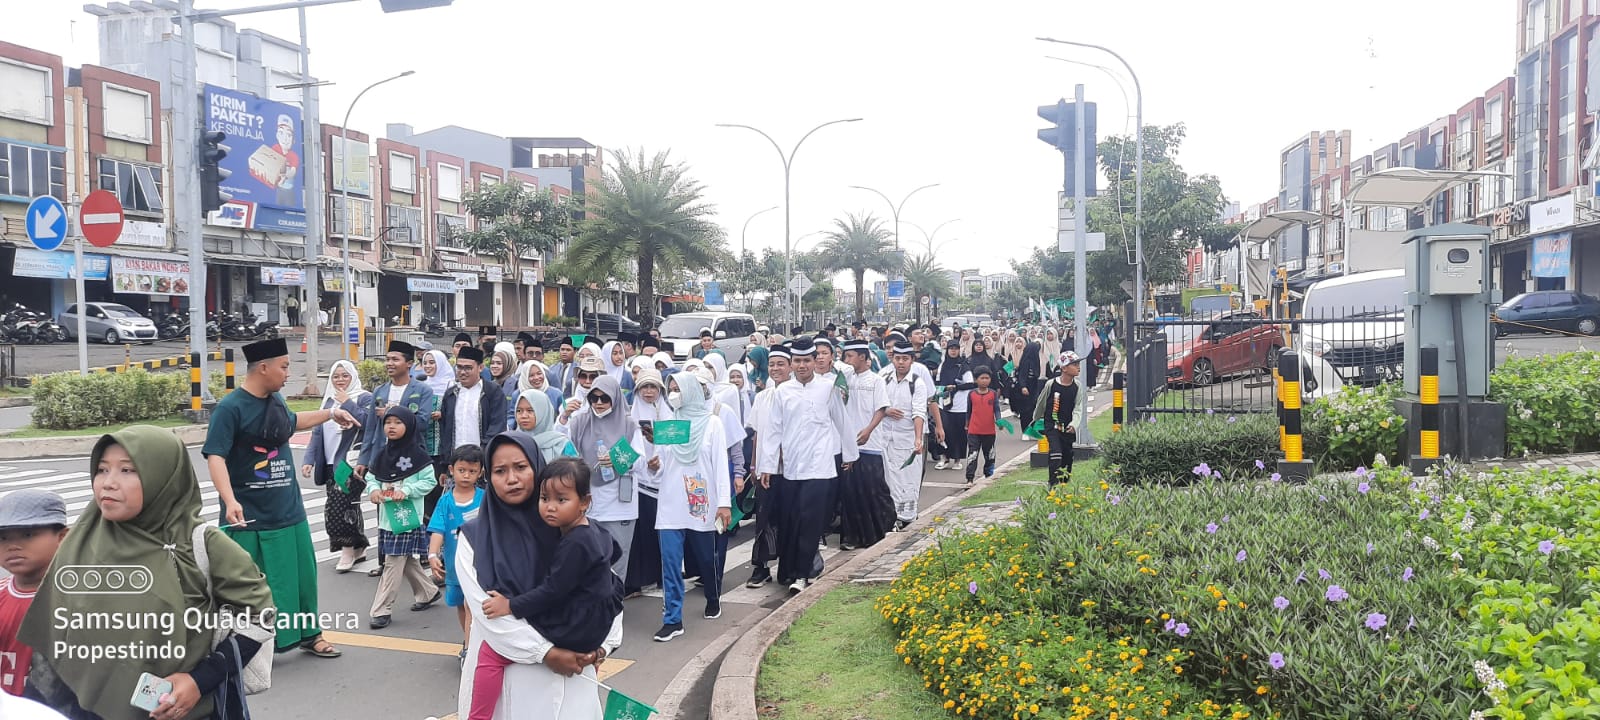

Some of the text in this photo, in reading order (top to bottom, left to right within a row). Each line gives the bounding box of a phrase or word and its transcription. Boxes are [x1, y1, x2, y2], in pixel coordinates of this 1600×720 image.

[210, 93, 246, 112] KIRIM
[211, 121, 265, 141] KE SINI AJA
[216, 206, 245, 220] JNE
[142, 260, 160, 272] BAKAR
[413, 279, 434, 289] RUMAH
[270, 459, 287, 467] HARI
